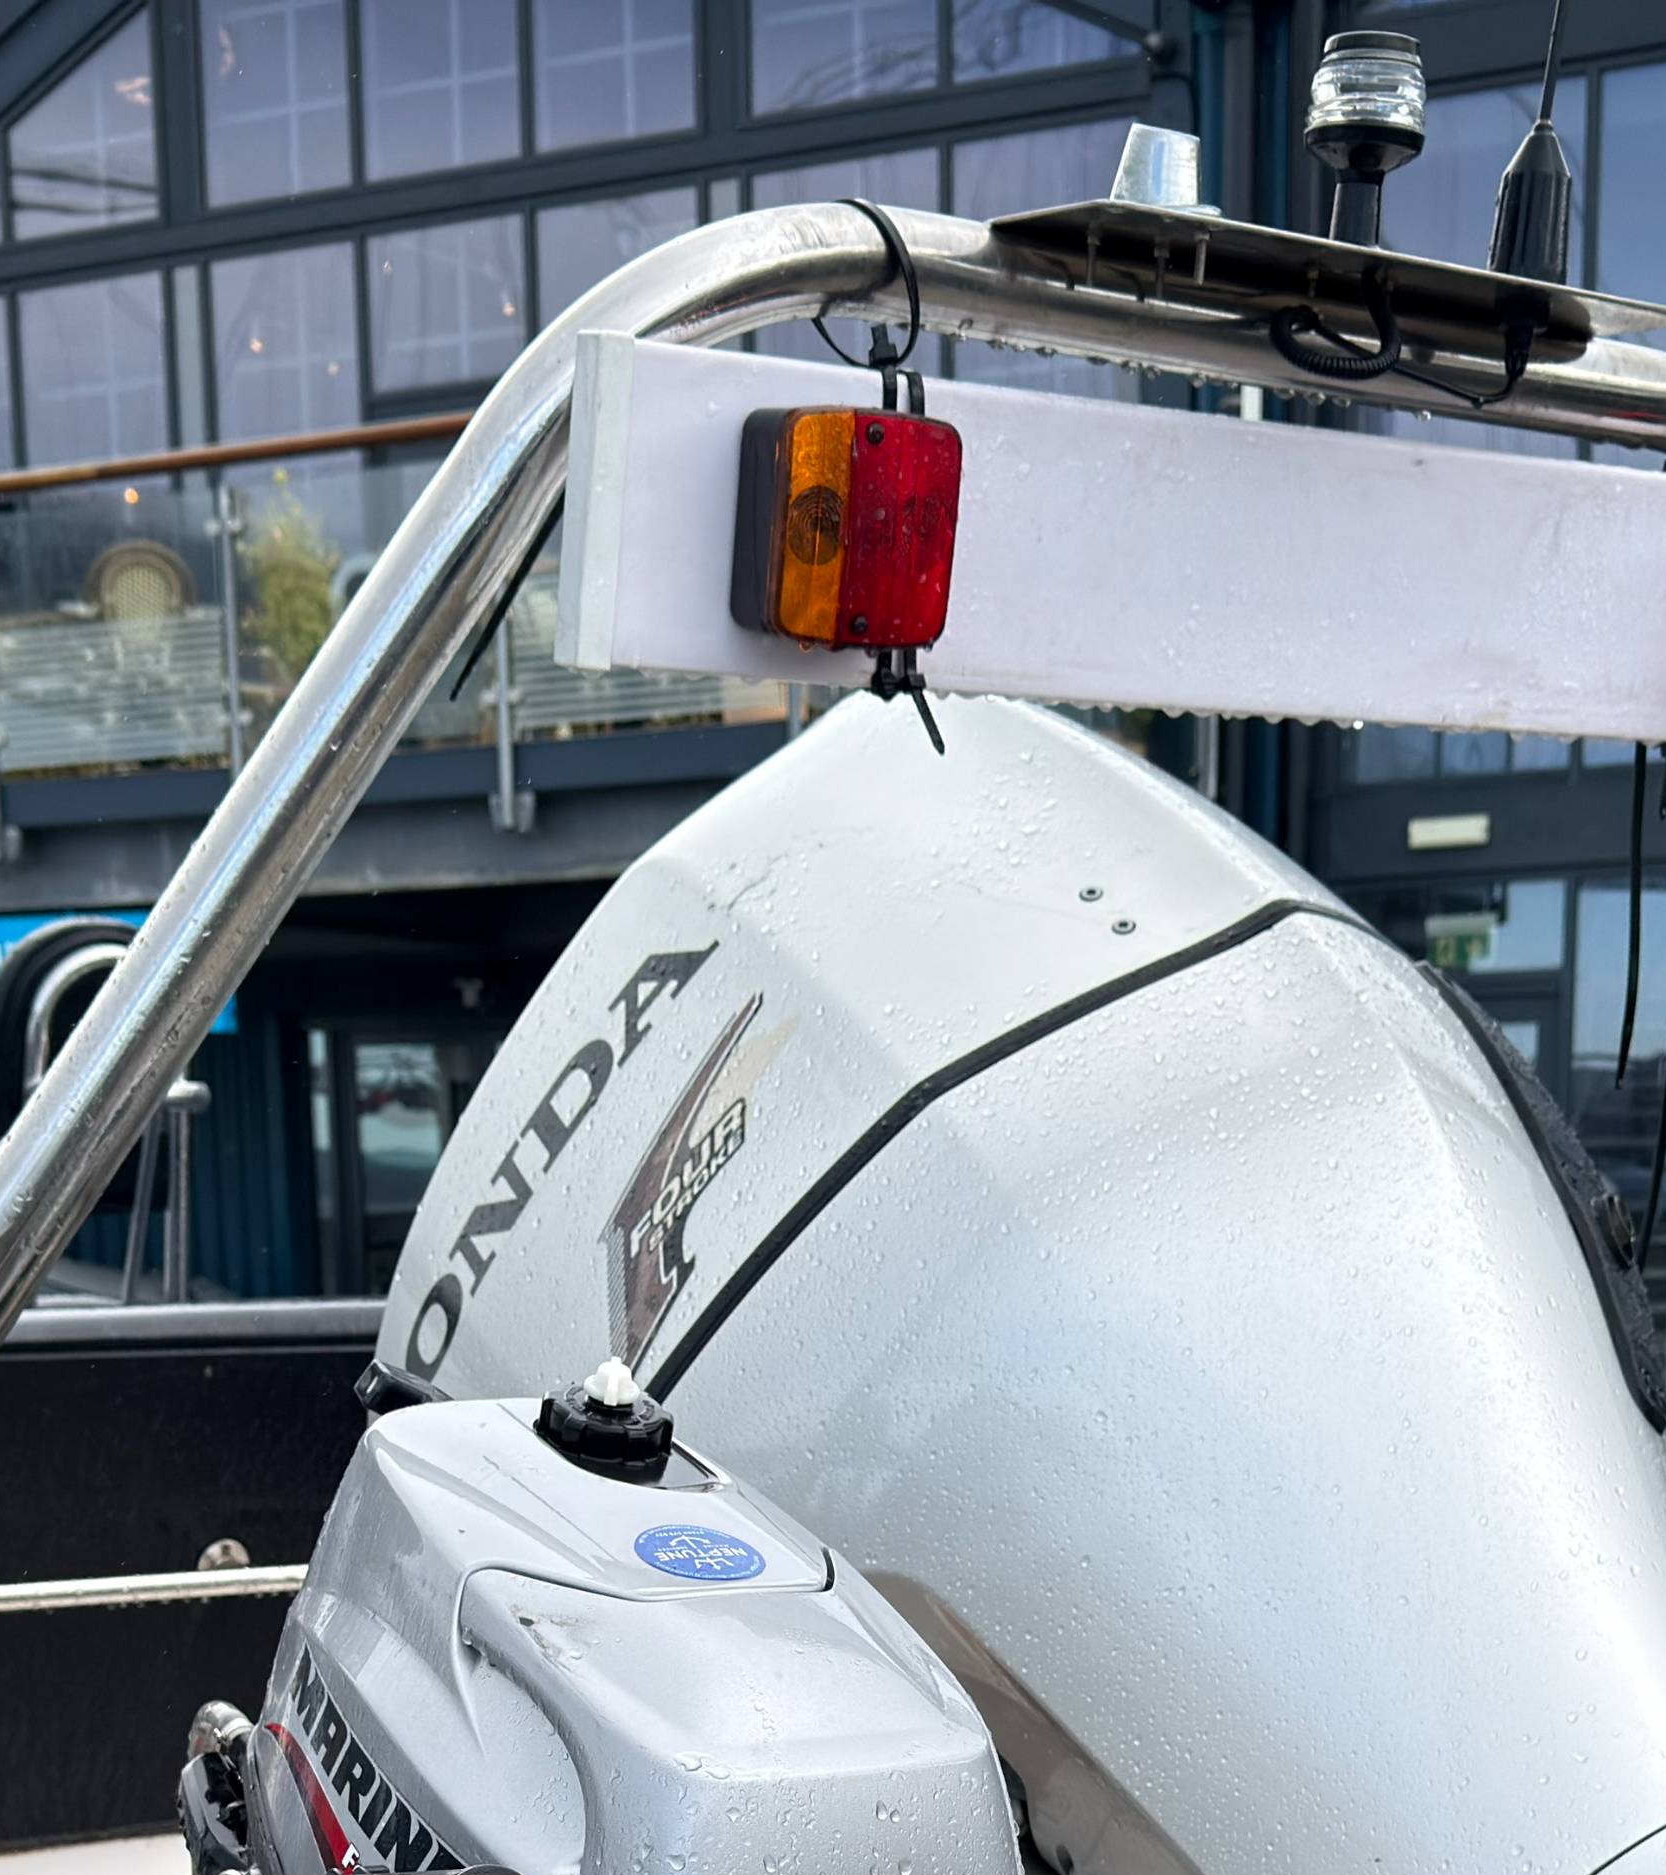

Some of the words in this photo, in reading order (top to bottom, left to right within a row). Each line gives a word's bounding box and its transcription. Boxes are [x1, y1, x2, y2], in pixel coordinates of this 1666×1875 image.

[406, 938, 719, 1382] ONDA
[630, 1099, 744, 1259] FOUR
[653, 1546, 749, 1562] NEPTUNE
[290, 1644, 467, 1871] MARIN
